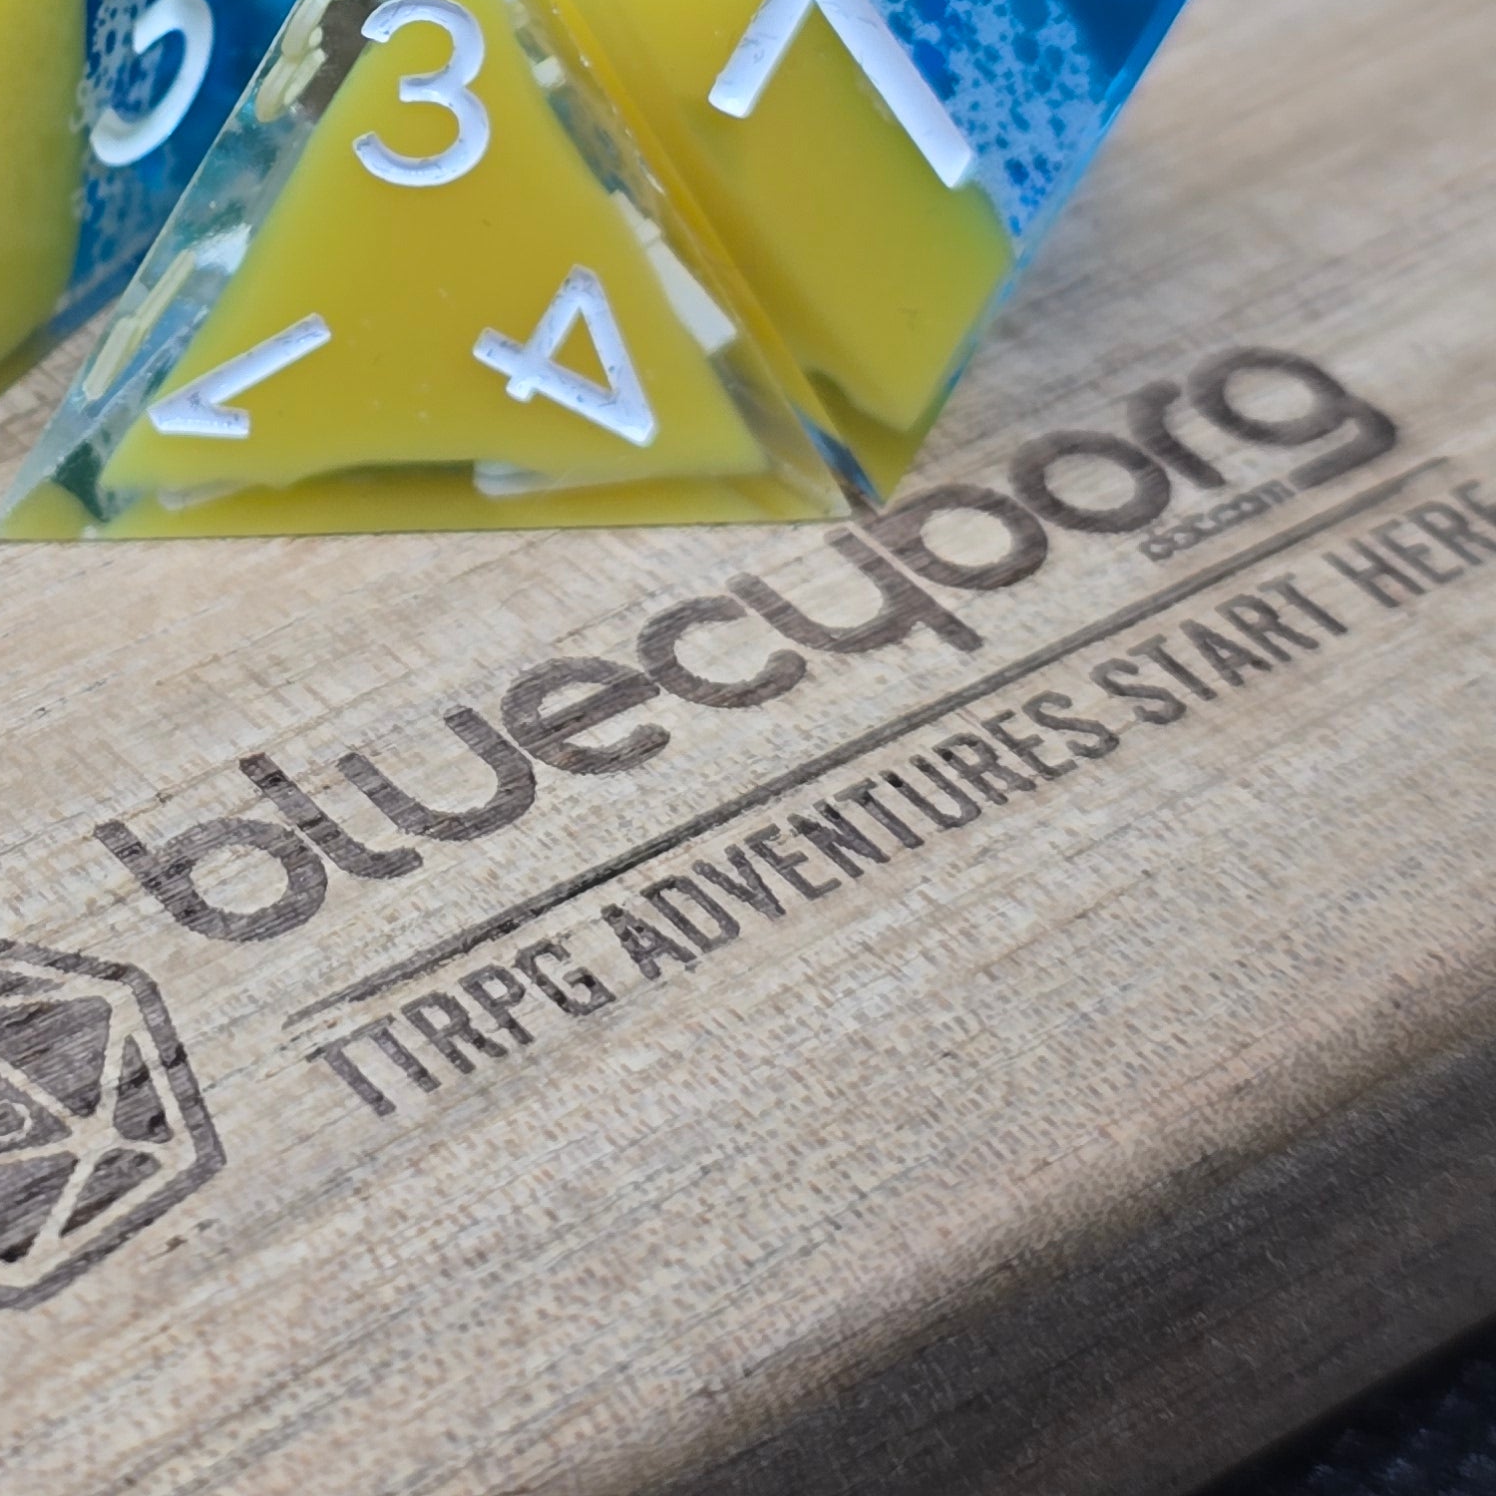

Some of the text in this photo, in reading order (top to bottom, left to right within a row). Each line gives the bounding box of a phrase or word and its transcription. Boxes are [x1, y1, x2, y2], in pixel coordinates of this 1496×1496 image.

[146, 312, 333, 440] 1
[473, 263, 659, 448] 4
[304, 937, 617, 1118] TTRPG
[601, 691, 1121, 982] ADVENTURES
[1089, 571, 1349, 726] START
